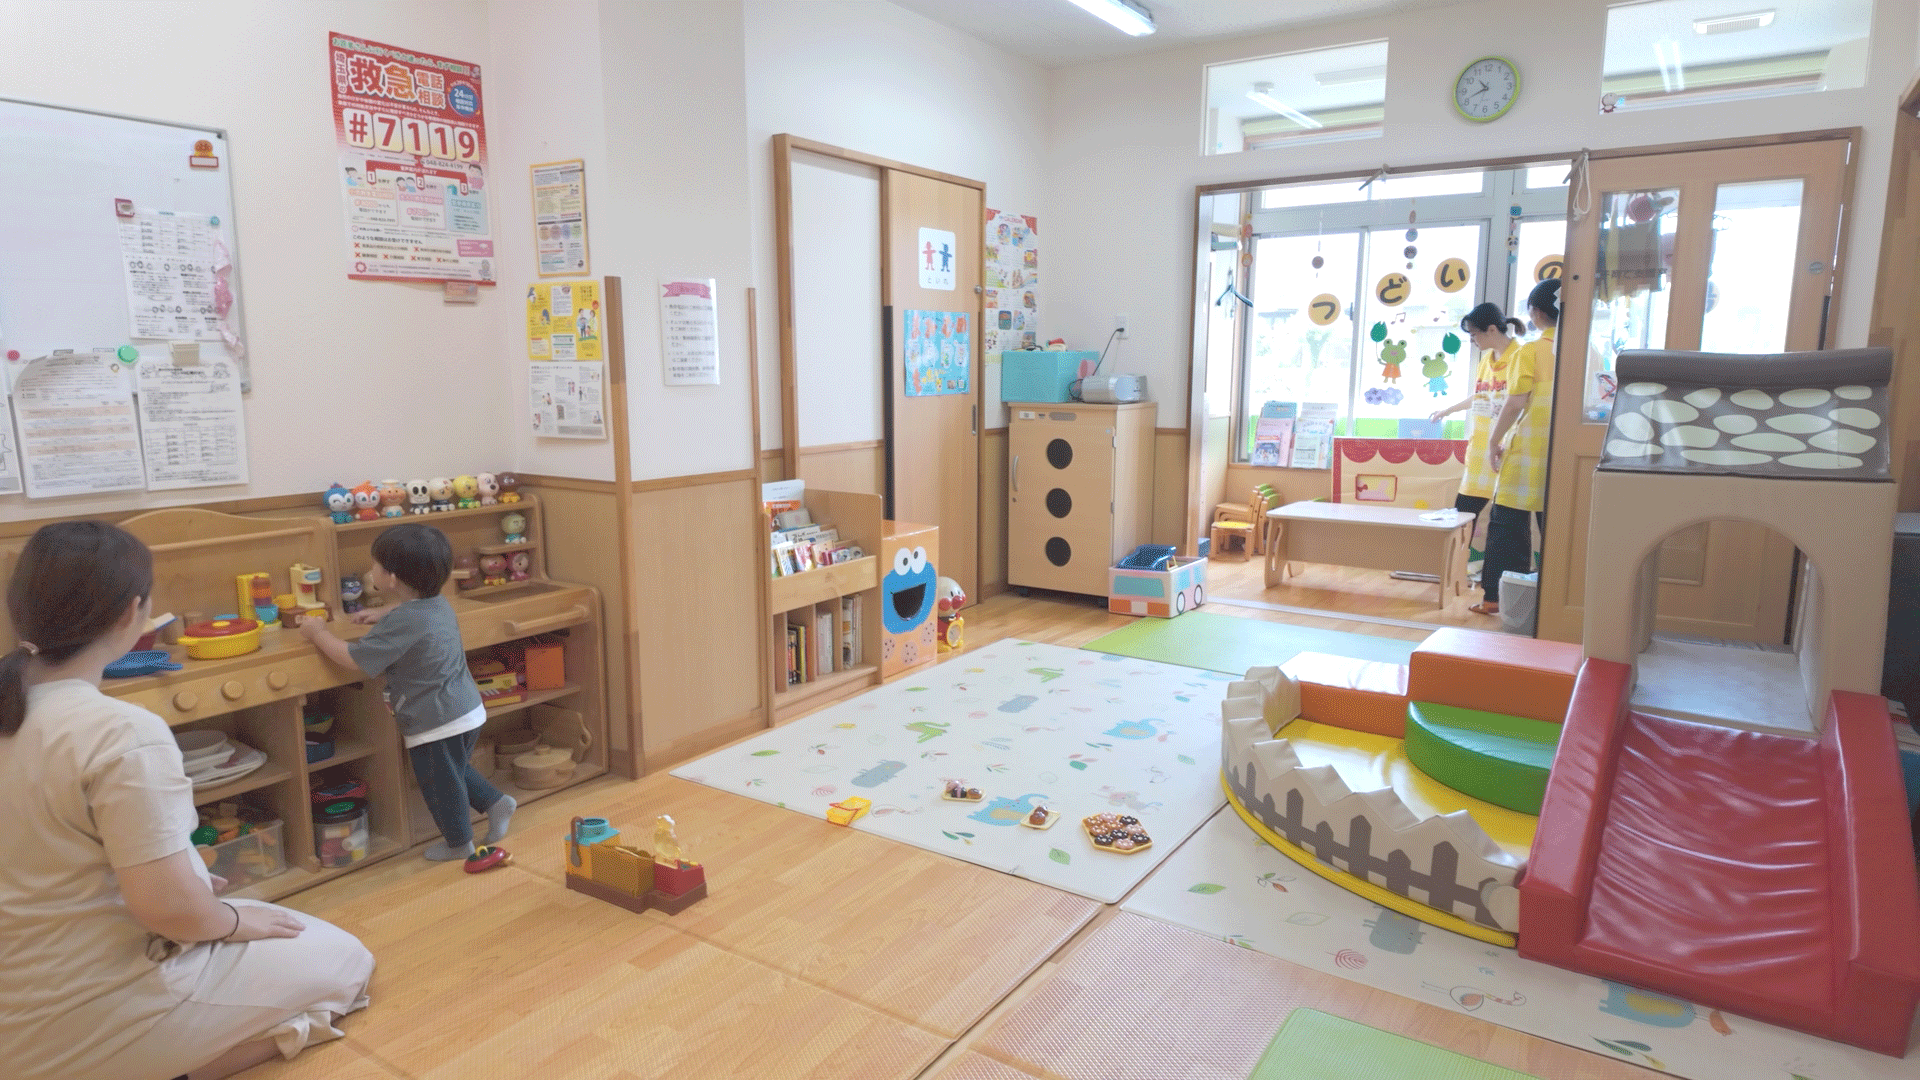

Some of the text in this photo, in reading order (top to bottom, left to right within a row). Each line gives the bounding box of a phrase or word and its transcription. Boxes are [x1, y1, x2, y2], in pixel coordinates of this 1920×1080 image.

[1474, 67, 1481, 76] 11
[1485, 64, 1493, 72] 12
[1498, 65, 1502, 73] 1
[348, 55, 417, 102] 救急
[415, 70, 444, 91] 電話
[1466, 77, 1475, 85] 10
[1504, 72, 1510, 81] 2
[1506, 82, 1513, 90] 3
[417, 87, 446, 110] 相談
[1502, 93, 1508, 101] 4
[1464, 98, 1470, 106] 8
[1494, 101, 1500, 110] 5
[1473, 103, 1479, 112] 7
[1482, 105, 1488, 114] 6
[349, 113, 476, 158] #7119
